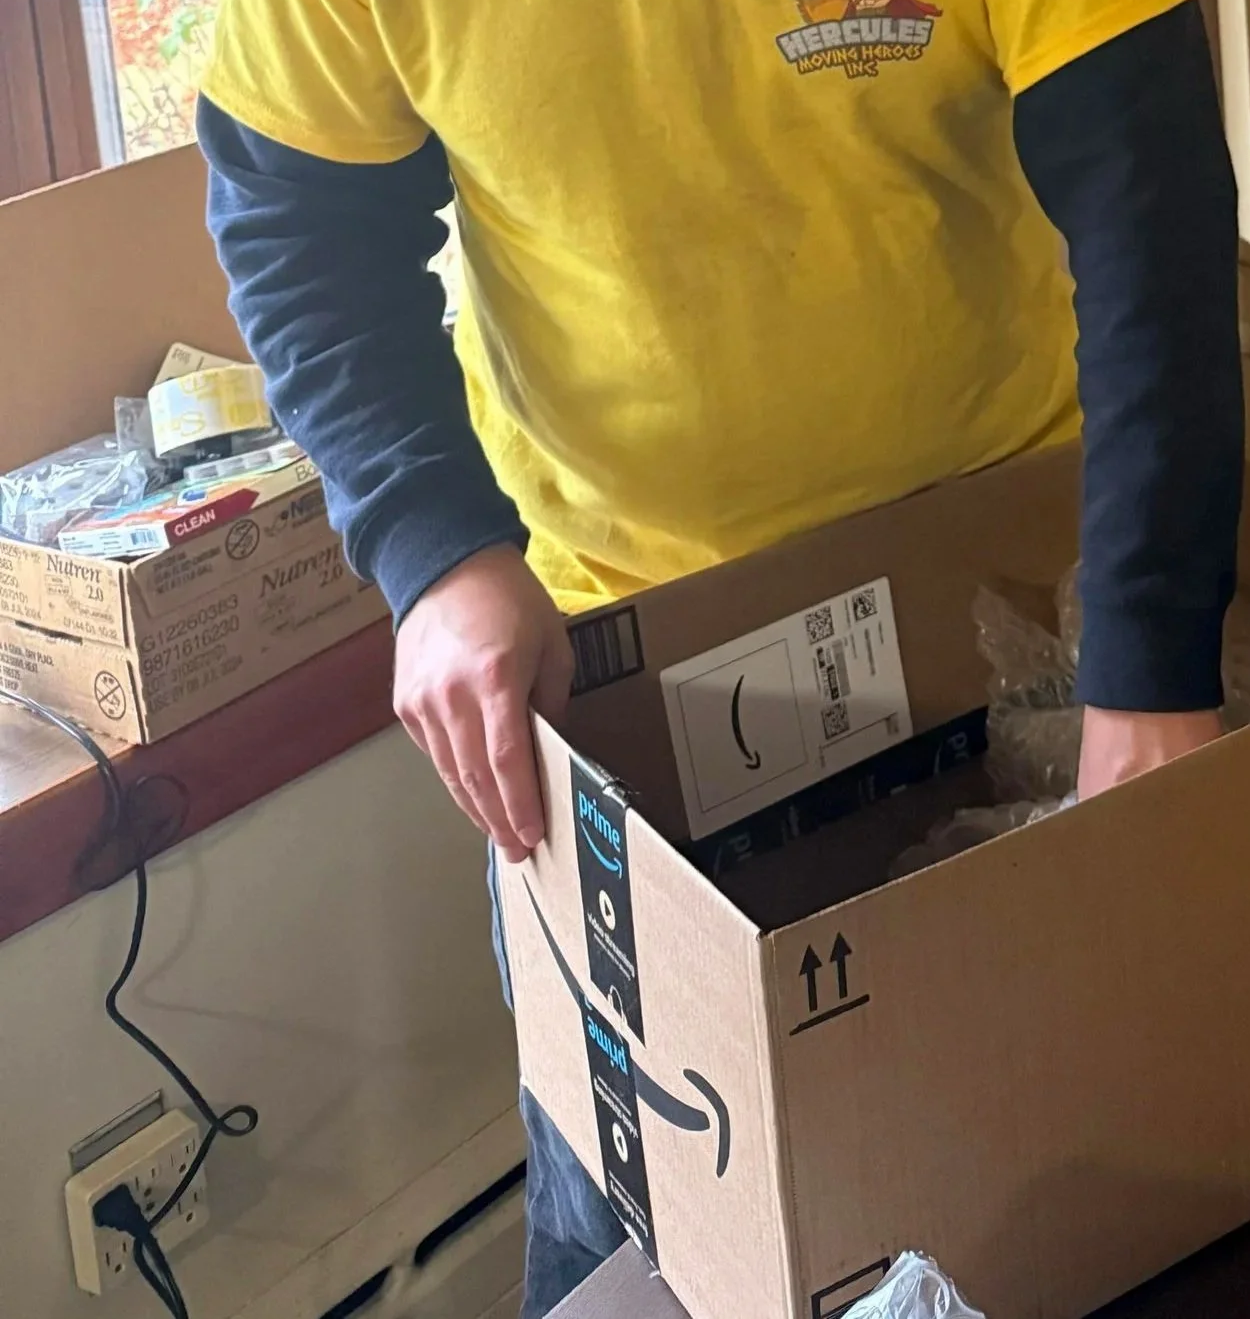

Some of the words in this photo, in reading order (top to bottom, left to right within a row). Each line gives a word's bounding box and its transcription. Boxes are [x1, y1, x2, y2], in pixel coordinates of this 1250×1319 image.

[777, 17, 934, 60] HERCULES
[798, 45, 859, 73] MOVING
[861, 44, 923, 60] HEROES
[847, 60, 878, 77] INC
[174, 509, 216, 537] CLEAN
[46, 554, 101, 583] Nutren
[259, 544, 341, 599] Nutren
[86, 585, 104, 602] 2.0
[579, 790, 621, 853] prime
[588, 1015, 629, 1076] prime
